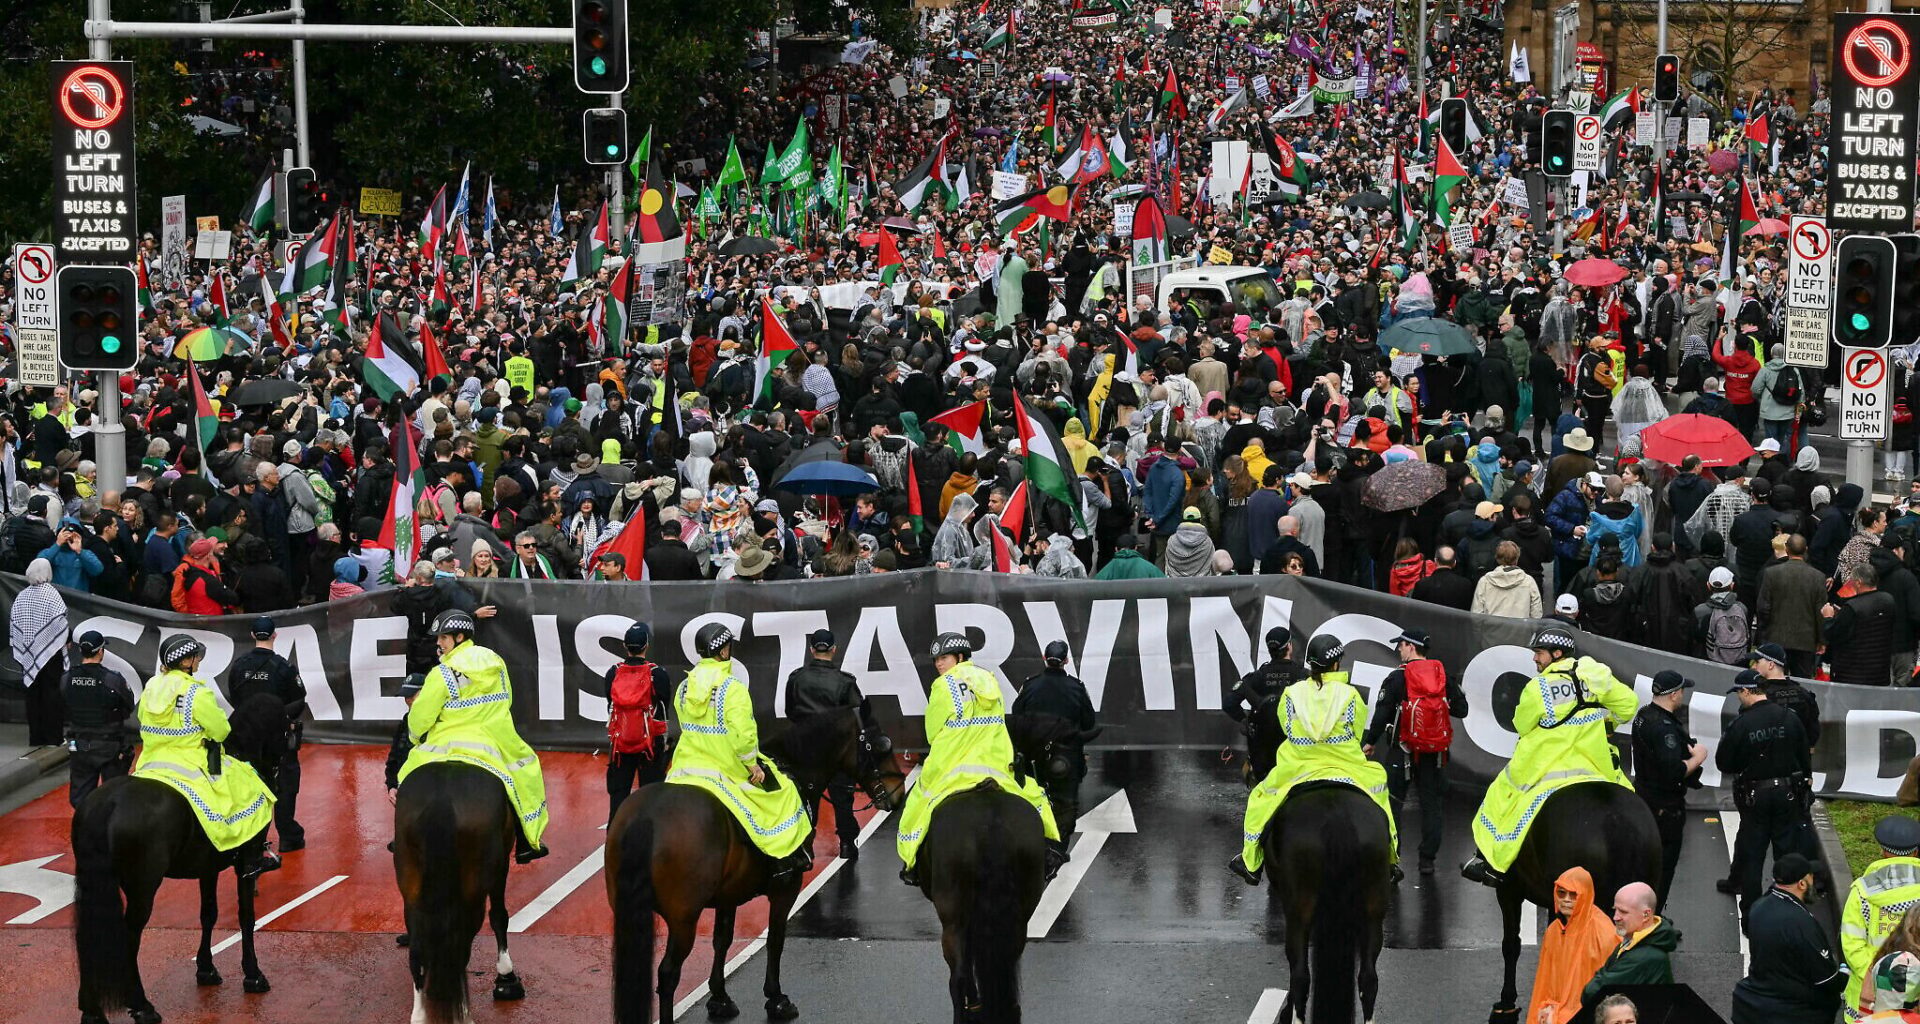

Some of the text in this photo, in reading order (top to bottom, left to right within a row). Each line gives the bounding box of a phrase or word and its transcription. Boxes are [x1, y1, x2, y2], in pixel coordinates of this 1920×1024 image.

[1073, 13, 1115, 26] PALESTINE
[1324, 82, 1345, 90] FOR
[1855, 87, 1894, 109] NO
[1843, 112, 1904, 133] LEFT
[75, 129, 111, 150] NO
[1580, 142, 1595, 151] NO
[1841, 136, 1905, 157] TURN
[66, 153, 121, 171] LEFT
[1837, 163, 1907, 180] BUSES &
[66, 175, 124, 193] TURN
[1842, 183, 1899, 200] TAXIS
[63, 200, 128, 214] BUSES &
[361, 200, 400, 213] GENOCIDE
[1833, 202, 1907, 220] EXCEPTED
[69, 218, 122, 233] TAXIS
[61, 236, 130, 251] EXCEPTED
[1798, 262, 1821, 277] NO
[1793, 278, 1825, 290] LEFT
[24, 287, 46, 301] NO
[1792, 292, 1826, 305] TURN
[22, 303, 49, 313] LEFT
[22, 315, 51, 326] TURN
[1791, 320, 1804, 329] HIRE
[1789, 330, 1824, 341] MOTORBIKES
[23, 343, 35, 351] HIRE
[1789, 341, 1824, 352] & BICYCLES
[22, 353, 55, 362] MOTORBIKES
[1788, 351, 1824, 362] EXCEPTED
[22, 362, 55, 371] & BICYCLES
[22, 372, 55, 381] EXCEPTED
[1852, 392, 1877, 407] NO
[1845, 410, 1882, 420] RIGHT
[1846, 423, 1880, 433] TURN
[532, 613, 640, 722] IS
[244, 672, 269, 680] PLICE
[71, 679, 97, 687] POLICE
[1748, 726, 1785, 744] POLICE
